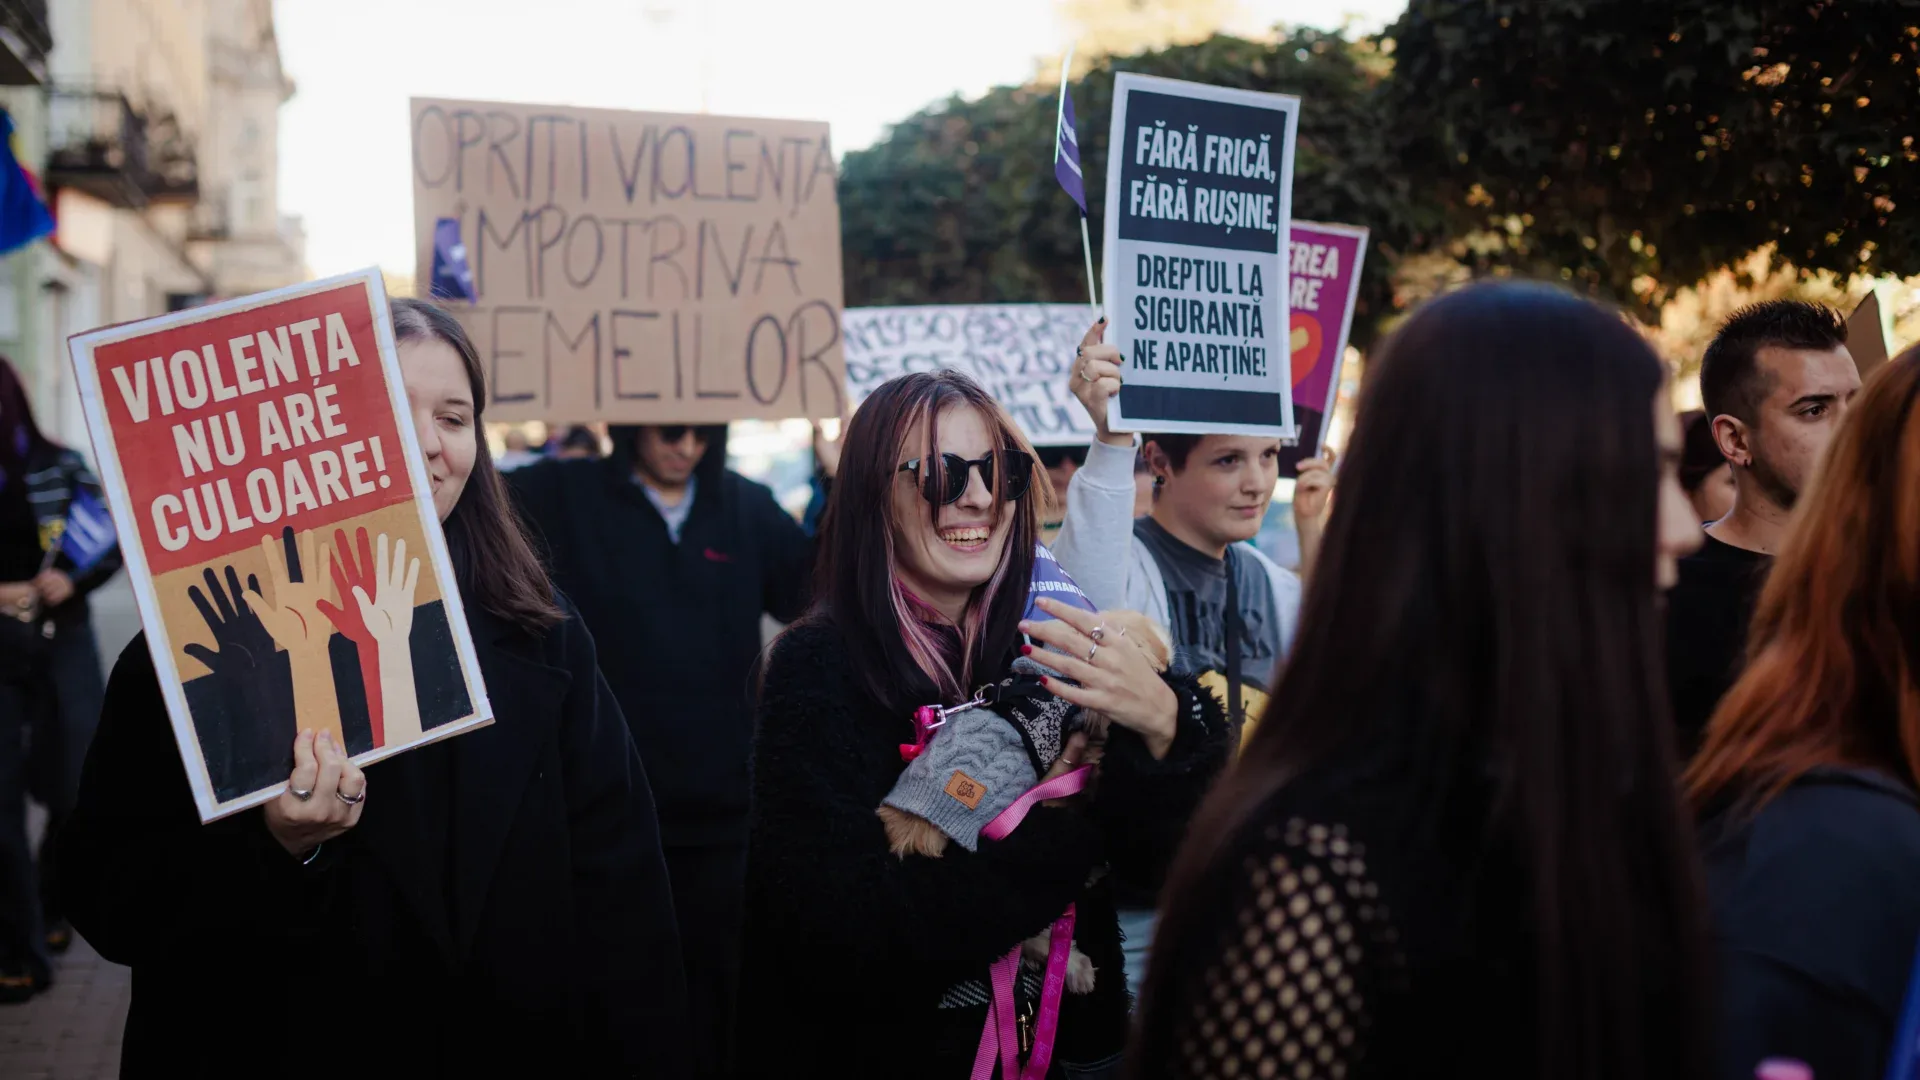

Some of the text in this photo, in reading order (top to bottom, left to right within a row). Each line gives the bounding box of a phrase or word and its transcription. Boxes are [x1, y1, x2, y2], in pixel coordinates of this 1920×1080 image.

[1136, 119, 1199, 172] FĂRĂ
[1203, 133, 1276, 184] FRICĂ,
[1129, 174, 1277, 235] FĂRĂ RUȘINE,
[453, 199, 801, 299] MPOTRIVA
[1136, 253, 1264, 297] DREPTUL LA
[1134, 294, 1264, 345] SIGURANȚĂ
[111, 312, 360, 423] VIOLENȚA
[1133, 338, 1267, 382] NE APARȚINE!
[171, 383, 348, 478] NU ARE
[151, 435, 391, 552] CULOARE!
